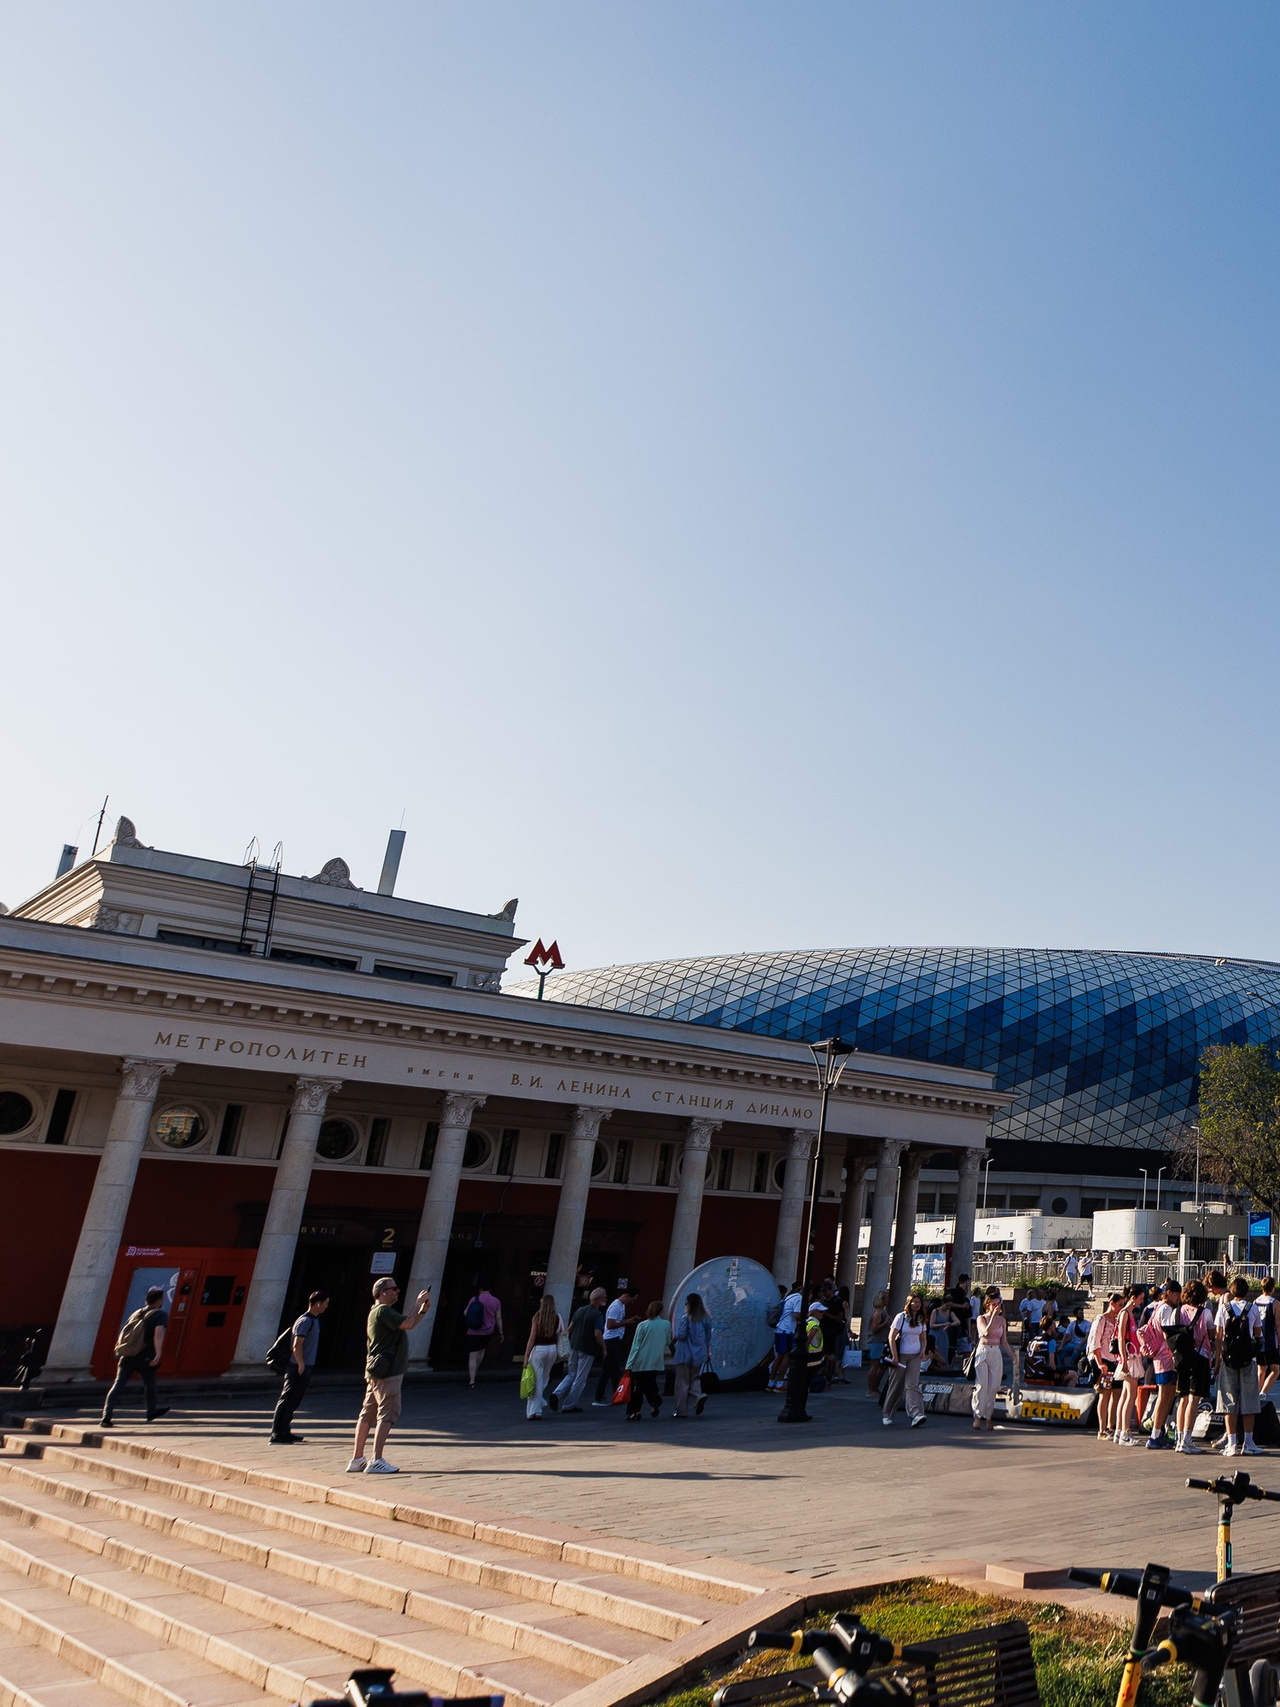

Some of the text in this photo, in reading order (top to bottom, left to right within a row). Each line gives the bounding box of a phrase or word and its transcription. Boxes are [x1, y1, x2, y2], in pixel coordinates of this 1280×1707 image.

[154, 1031, 368, 1068] МЕТРОПОЛИТЕН
[556, 1079, 632, 1098] ЛЕНИНА
[652, 1090, 734, 1110] СТАНЦИЯ
[746, 1102, 813, 1119] ДИНАМО
[382, 1228, 396, 1243] 2
